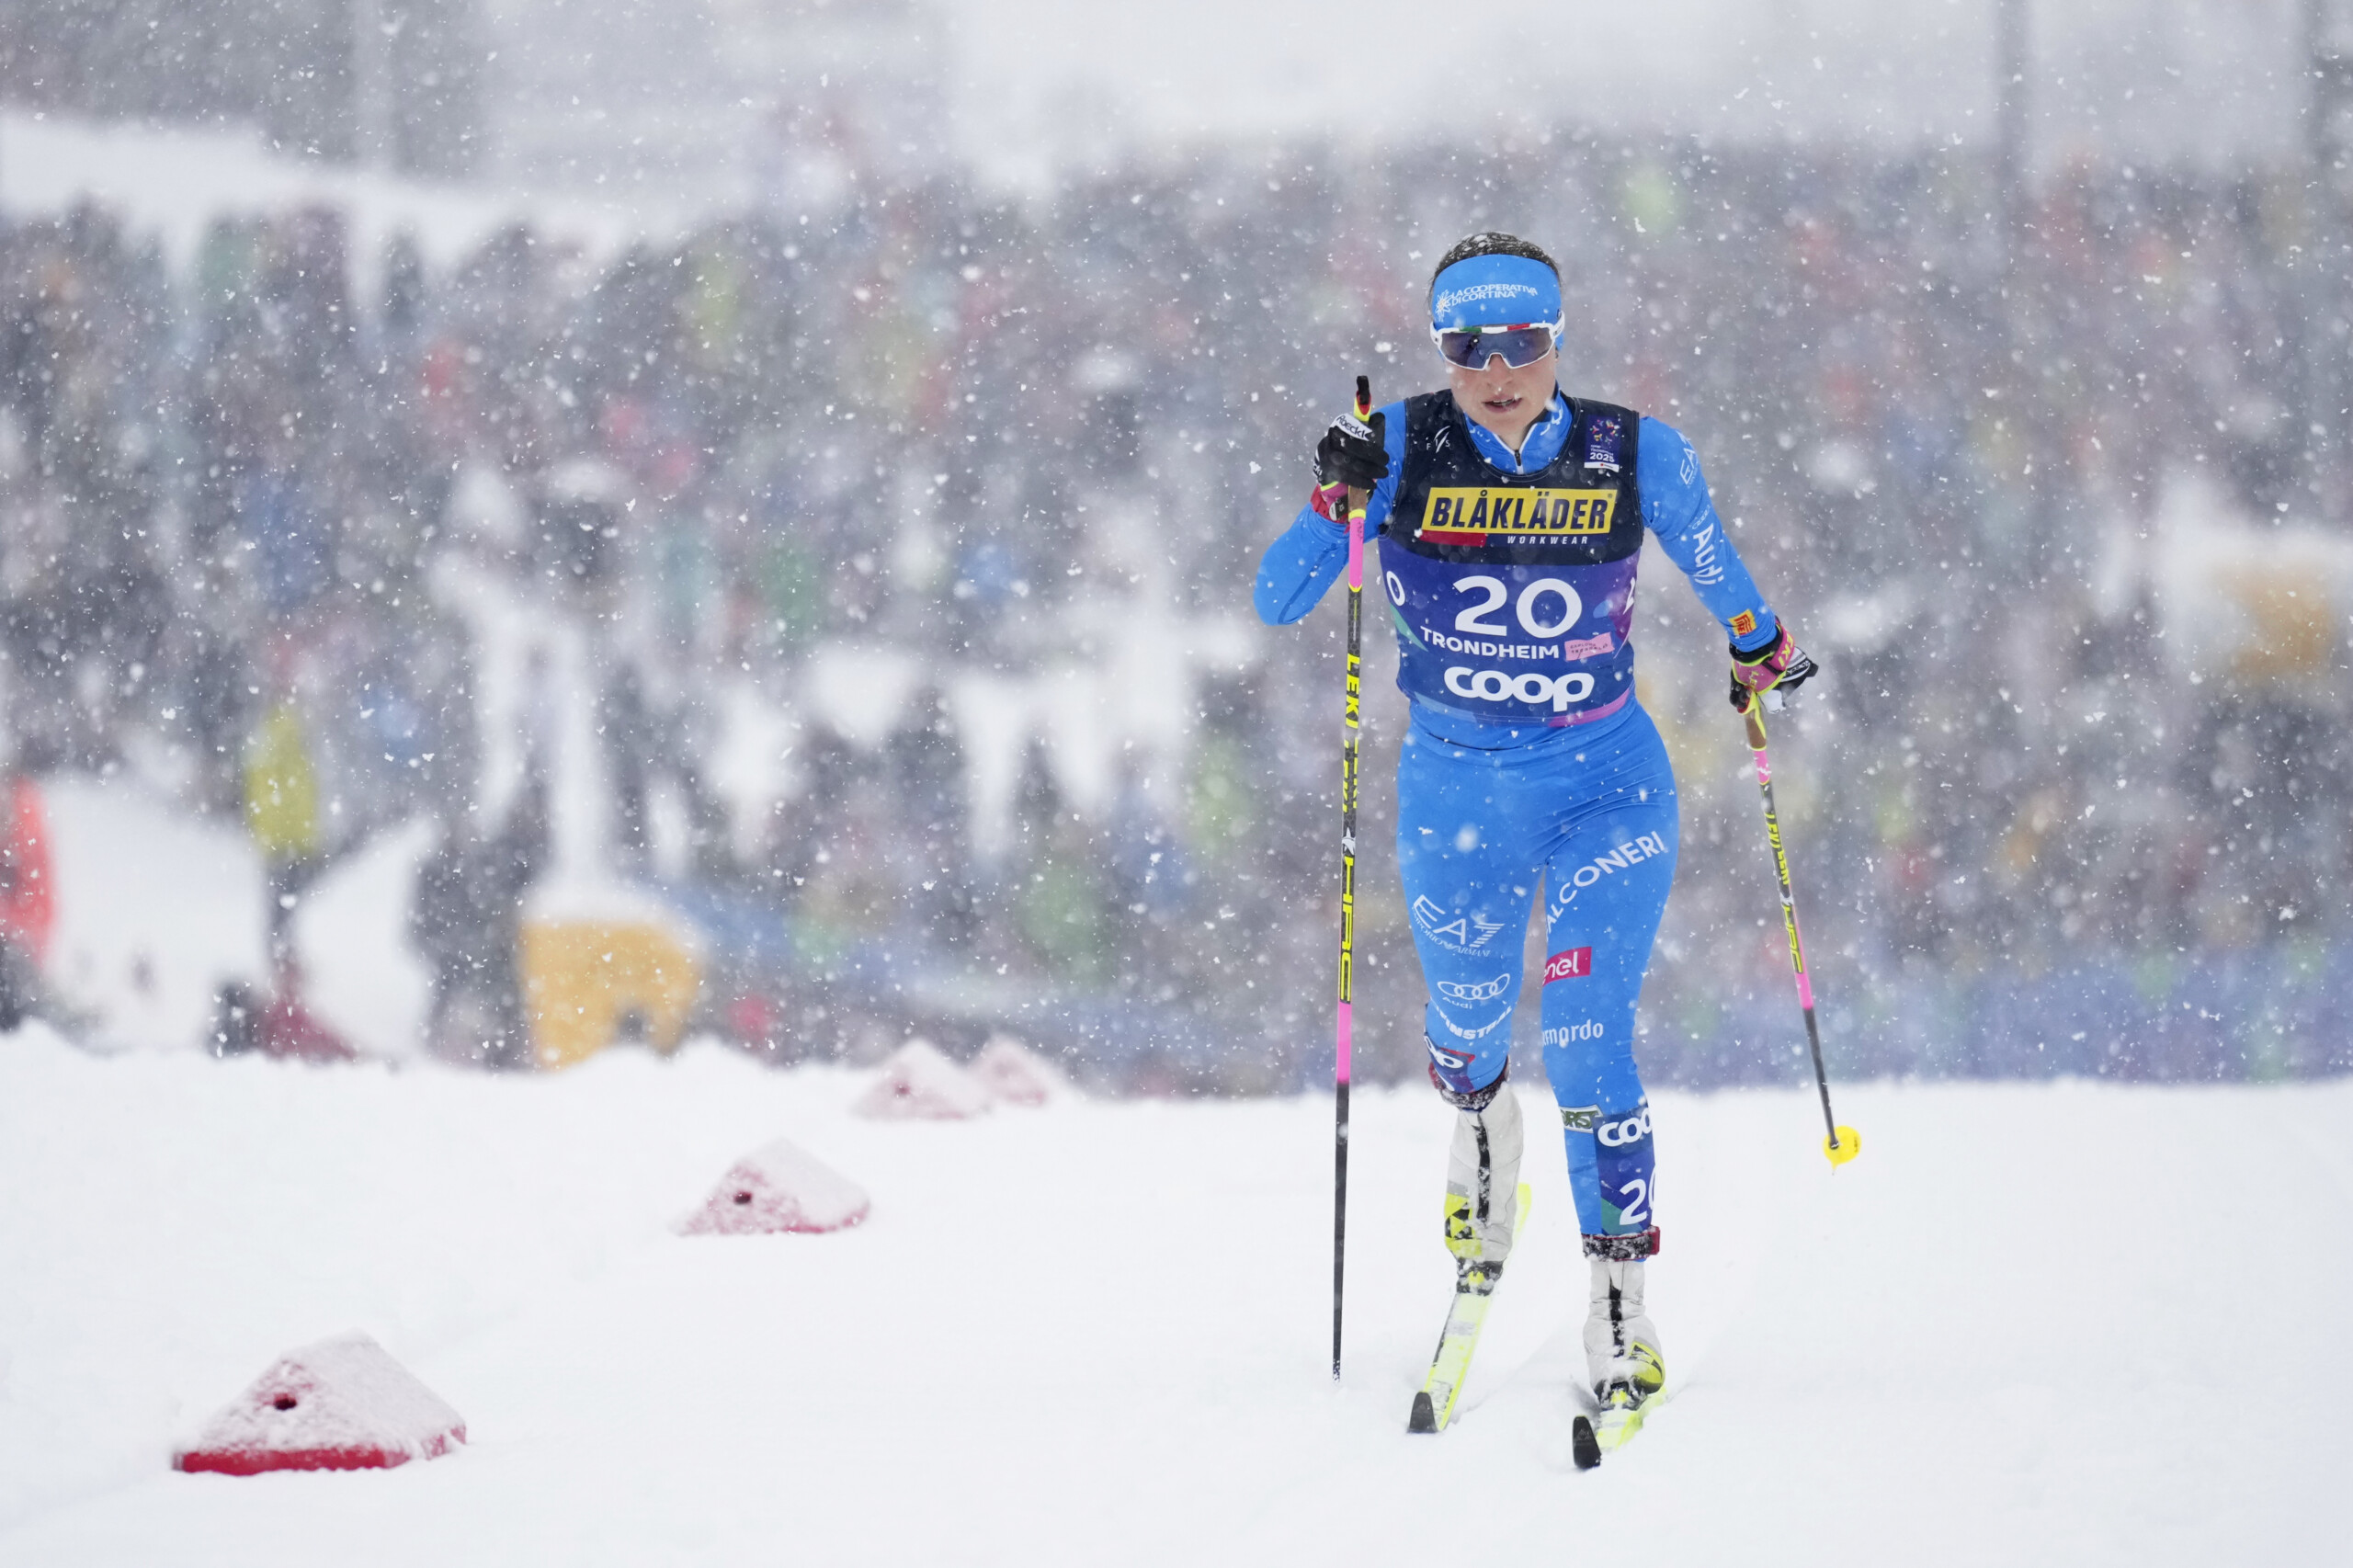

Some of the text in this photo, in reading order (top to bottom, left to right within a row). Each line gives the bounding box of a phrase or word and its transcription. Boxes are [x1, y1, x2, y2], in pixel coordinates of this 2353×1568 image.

[1451, 283, 1539, 301] LA COOPERATIVA
[1451, 290, 1517, 307] DI CORTINA
[1430, 489, 1608, 529] BLÅKLÄDER
[1506, 535, 1588, 545] WORKWEAR
[1693, 523, 1724, 585] Audi
[1453, 574, 1583, 639] 20
[1420, 626, 1559, 660] TRONDHEIM
[1778, 632, 1793, 667] EKI
[1345, 653, 1360, 729] LEKI
[1443, 666, 1595, 712] coop
[1546, 831, 1665, 942] ALCONERI
[1413, 894, 1506, 949] EA7
[1442, 996, 1473, 1009] Audi
[1597, 1108, 1653, 1147] coo
